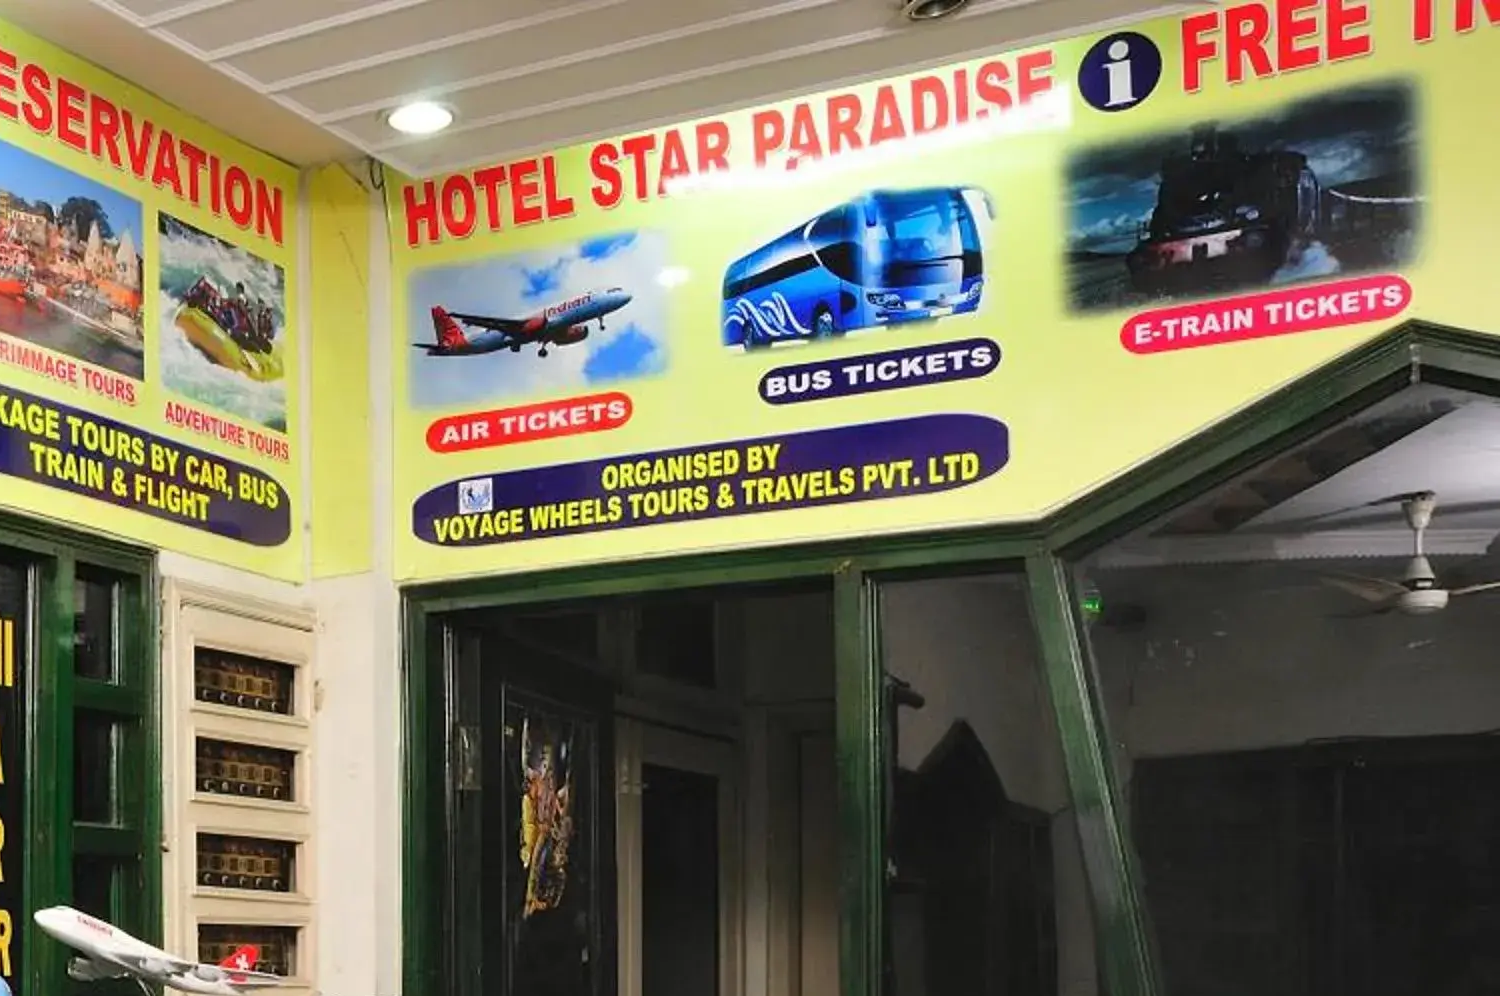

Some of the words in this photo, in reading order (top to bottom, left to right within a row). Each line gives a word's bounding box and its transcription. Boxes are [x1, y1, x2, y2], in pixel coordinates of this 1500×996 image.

[1181, 0, 1372, 92] FREE
[403, 156, 575, 246] HOTEL
[590, 121, 730, 208] STAR
[752, 50, 1053, 170] PARADISE
[1134, 307, 1253, 346] E-TRAIN
[1263, 284, 1403, 326] TICKETS
[83, 366, 135, 404] TOURS
[767, 369, 832, 398] BUS
[842, 346, 992, 390] TICKETS
[166, 402, 244, 446] ADVENTURE
[249, 430, 289, 462] TOURS
[441, 420, 489, 446] AIR
[500, 399, 626, 437] TICKETS
[30, 443, 103, 491] TRAIN
[111, 470, 128, 498] &
[134, 473, 210, 523] FLIGHT
[67, 412, 145, 466] TOURS
[151, 442, 181, 473] BY
[185, 454, 233, 500] CAR,
[238, 474, 278, 509] BUS
[601, 449, 739, 490] ORGANISED
[746, 444, 781, 474] BY
[434, 508, 523, 544] VOYAGE
[529, 494, 621, 531] WHEELS
[628, 485, 709, 521] TOURS
[716, 483, 735, 509] &
[740, 467, 855, 508] TRAVELS
[861, 461, 921, 492] PVT.
[928, 452, 979, 485] LTD
